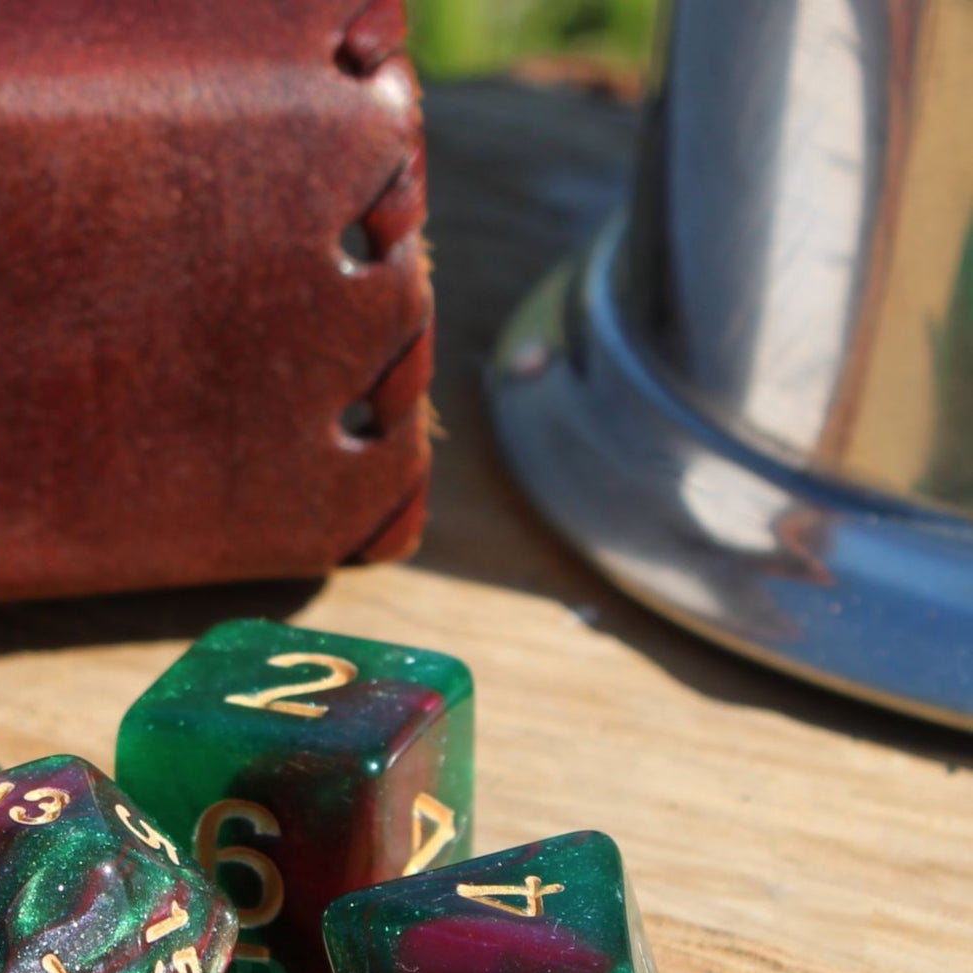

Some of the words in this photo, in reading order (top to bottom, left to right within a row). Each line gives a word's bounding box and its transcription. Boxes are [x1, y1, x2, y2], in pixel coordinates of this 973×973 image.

[224, 652, 358, 718] 2
[192, 798, 285, 962] 6
[456, 875, 564, 917] 4
